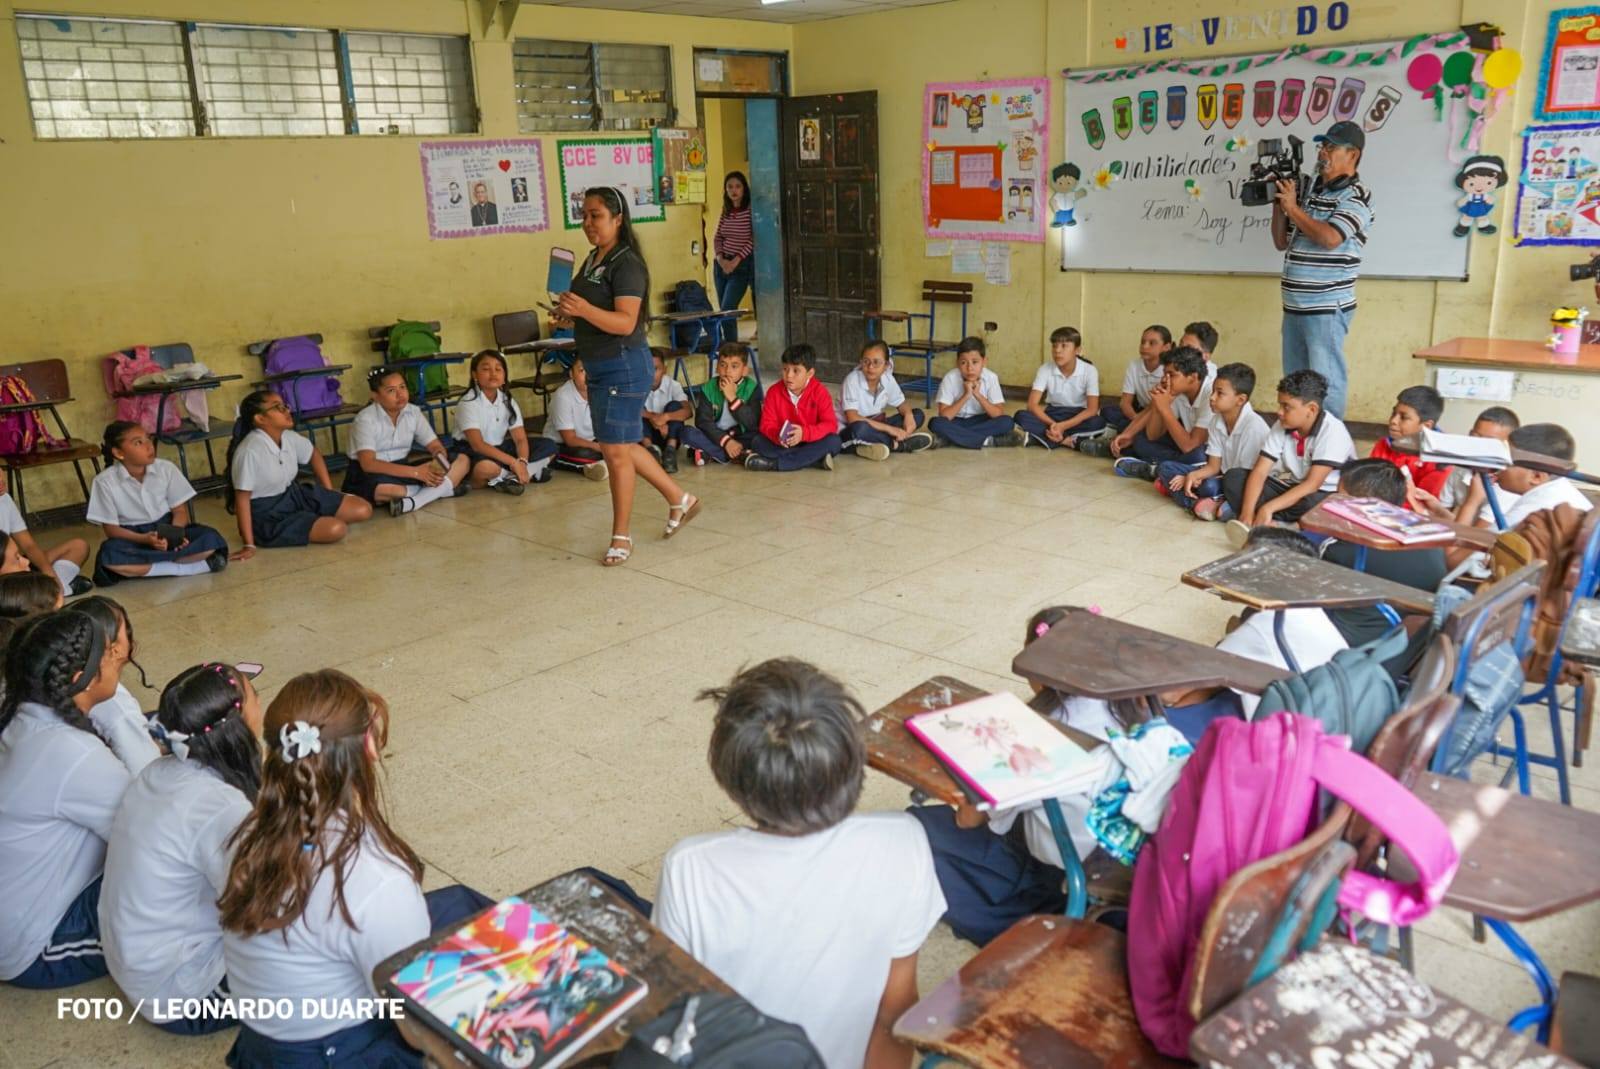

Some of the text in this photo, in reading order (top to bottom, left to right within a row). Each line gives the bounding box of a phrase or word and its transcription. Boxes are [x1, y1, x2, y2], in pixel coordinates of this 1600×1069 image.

[1086, 85, 1393, 141] BIENVENIDOS
[1204, 134, 1215, 146] a
[1122, 150, 1236, 181] Habilidades
[1240, 215, 1272, 243] pro
